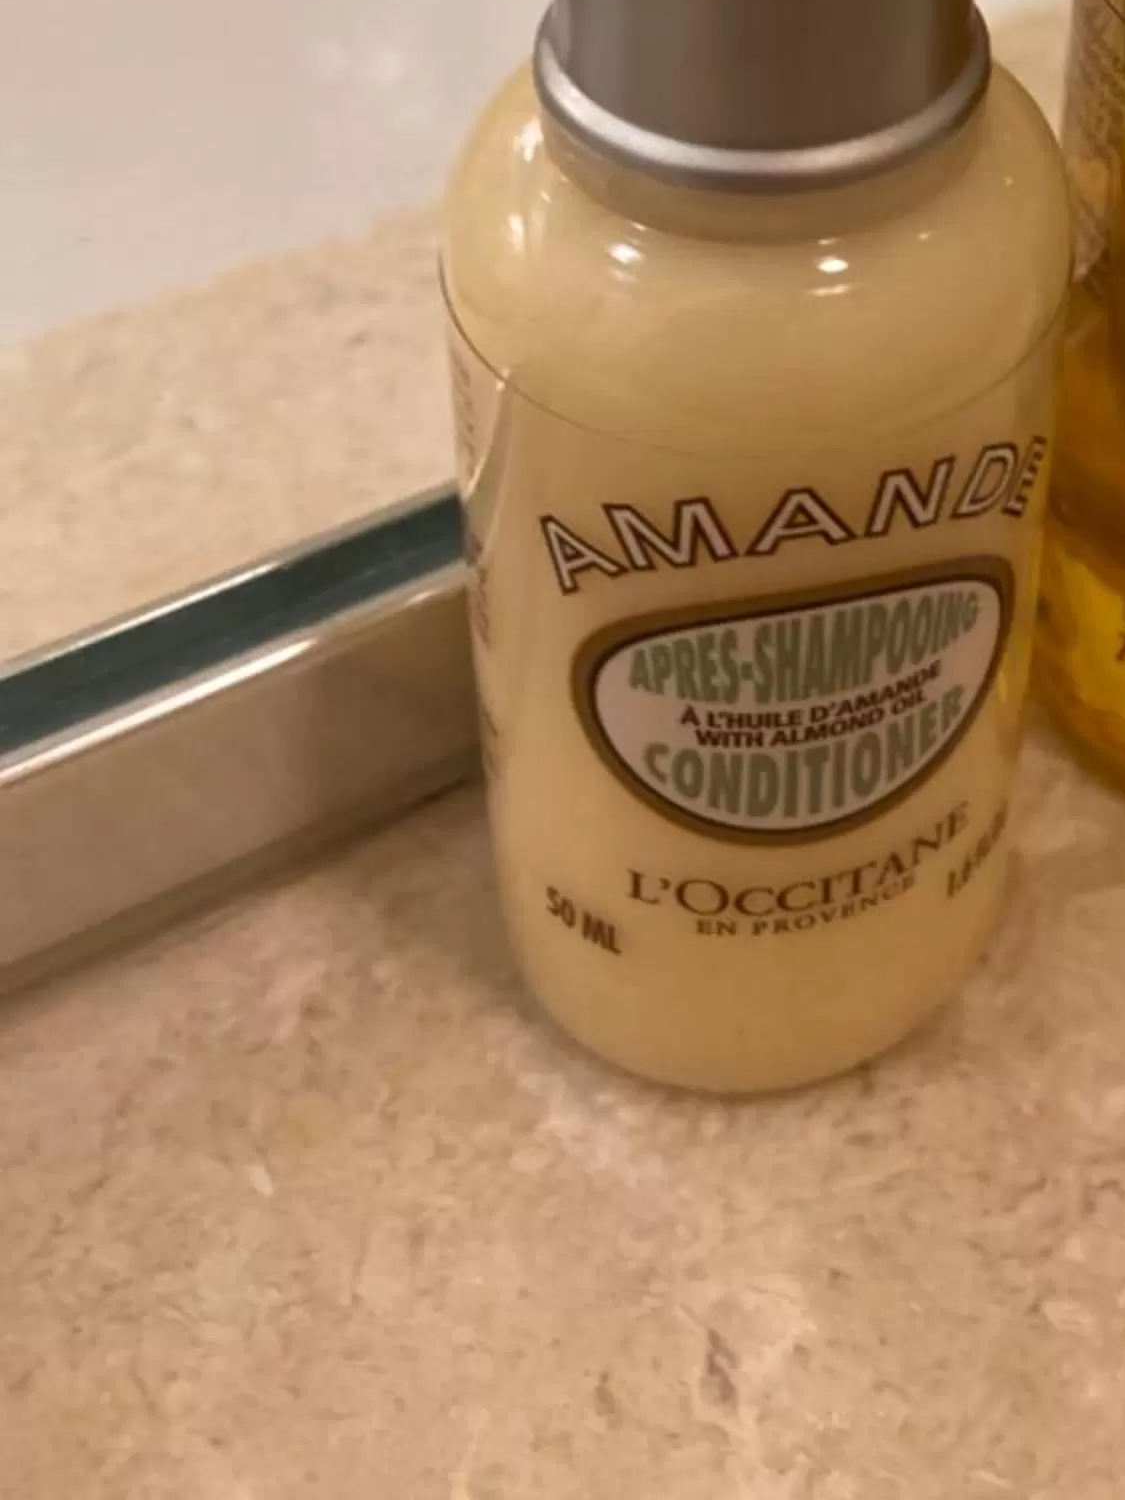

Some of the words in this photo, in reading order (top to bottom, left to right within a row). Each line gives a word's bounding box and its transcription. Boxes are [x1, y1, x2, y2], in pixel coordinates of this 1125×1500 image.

[539, 434, 1048, 596] AMANDE
[628, 590, 979, 705] APRES-SHAMPOOING
[694, 729, 764, 749] WITH
[769, 705, 886, 747] ALMOND
[889, 687, 930, 716] OIL
[706, 711, 802, 731] L'HUILE
[808, 659, 942, 724] D'AMANDE
[642, 685, 965, 819] CONDITIONER
[627, 800, 971, 917] L'OCCITANE
[544, 884, 577, 929] 50
[581, 912, 623, 956] ML
[695, 918, 738, 938] EN
[750, 874, 917, 937] PROVENCE
